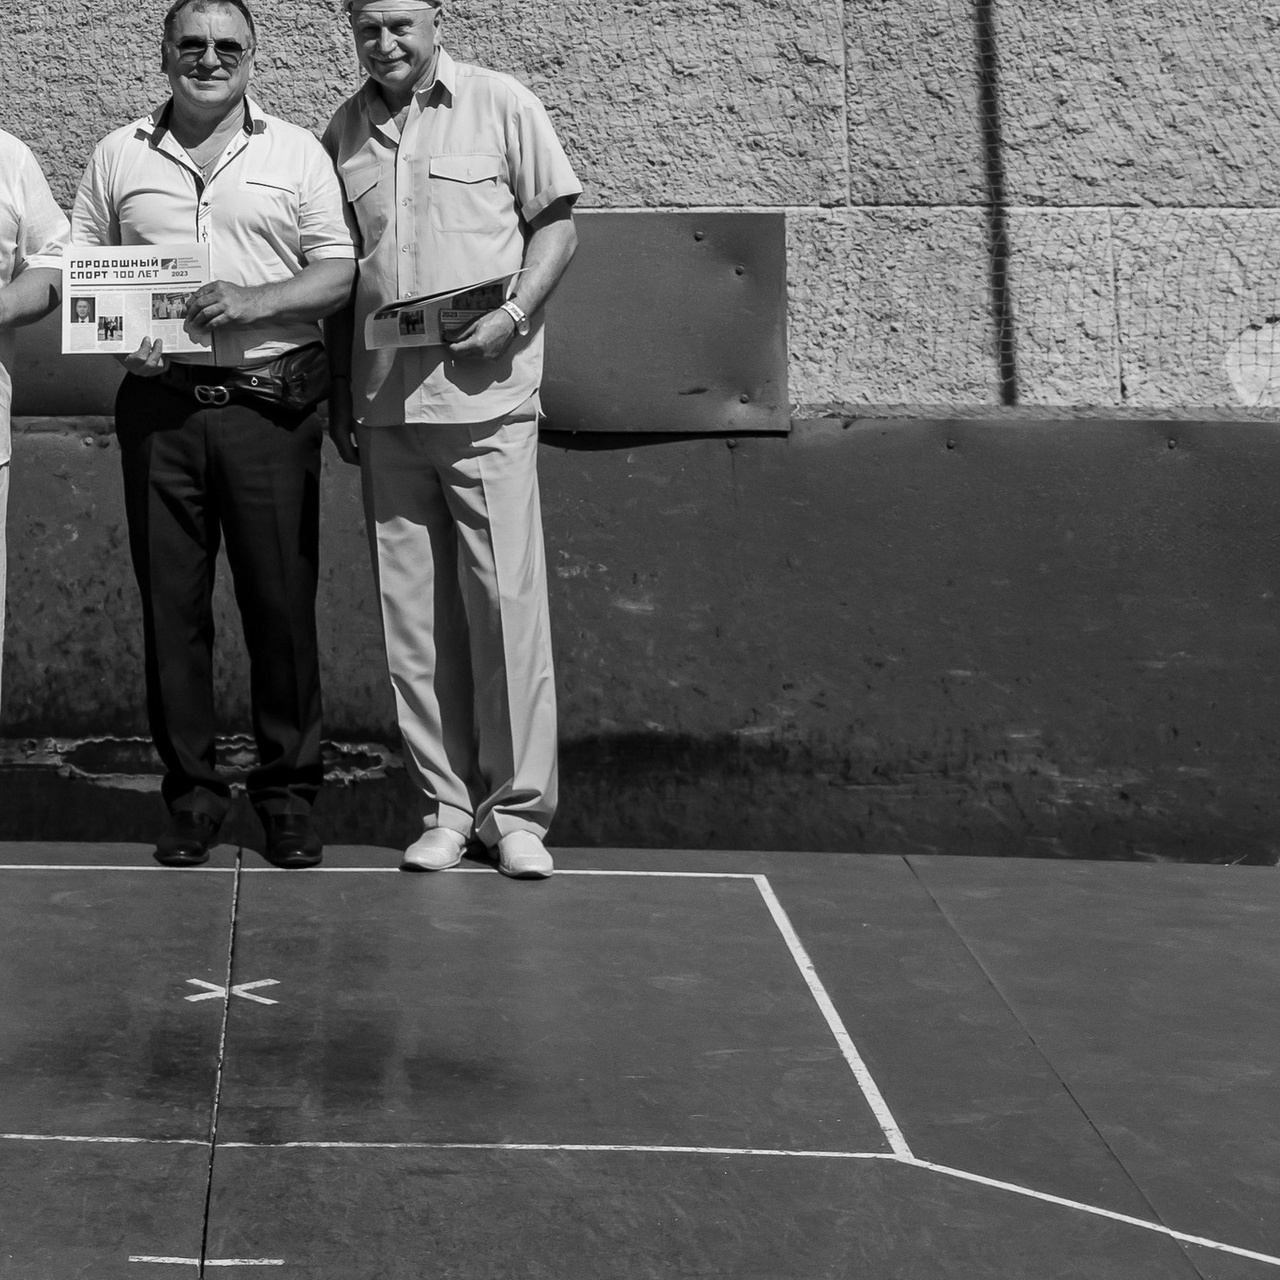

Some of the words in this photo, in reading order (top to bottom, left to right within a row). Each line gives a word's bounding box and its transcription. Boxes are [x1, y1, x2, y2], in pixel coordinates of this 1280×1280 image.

[70, 257, 159, 268] ГОРОДОШНЫЙ
[70, 270, 108, 279] СПОРТ
[113, 270, 135, 279] 100
[137, 269, 160, 278] ЛЕТ
